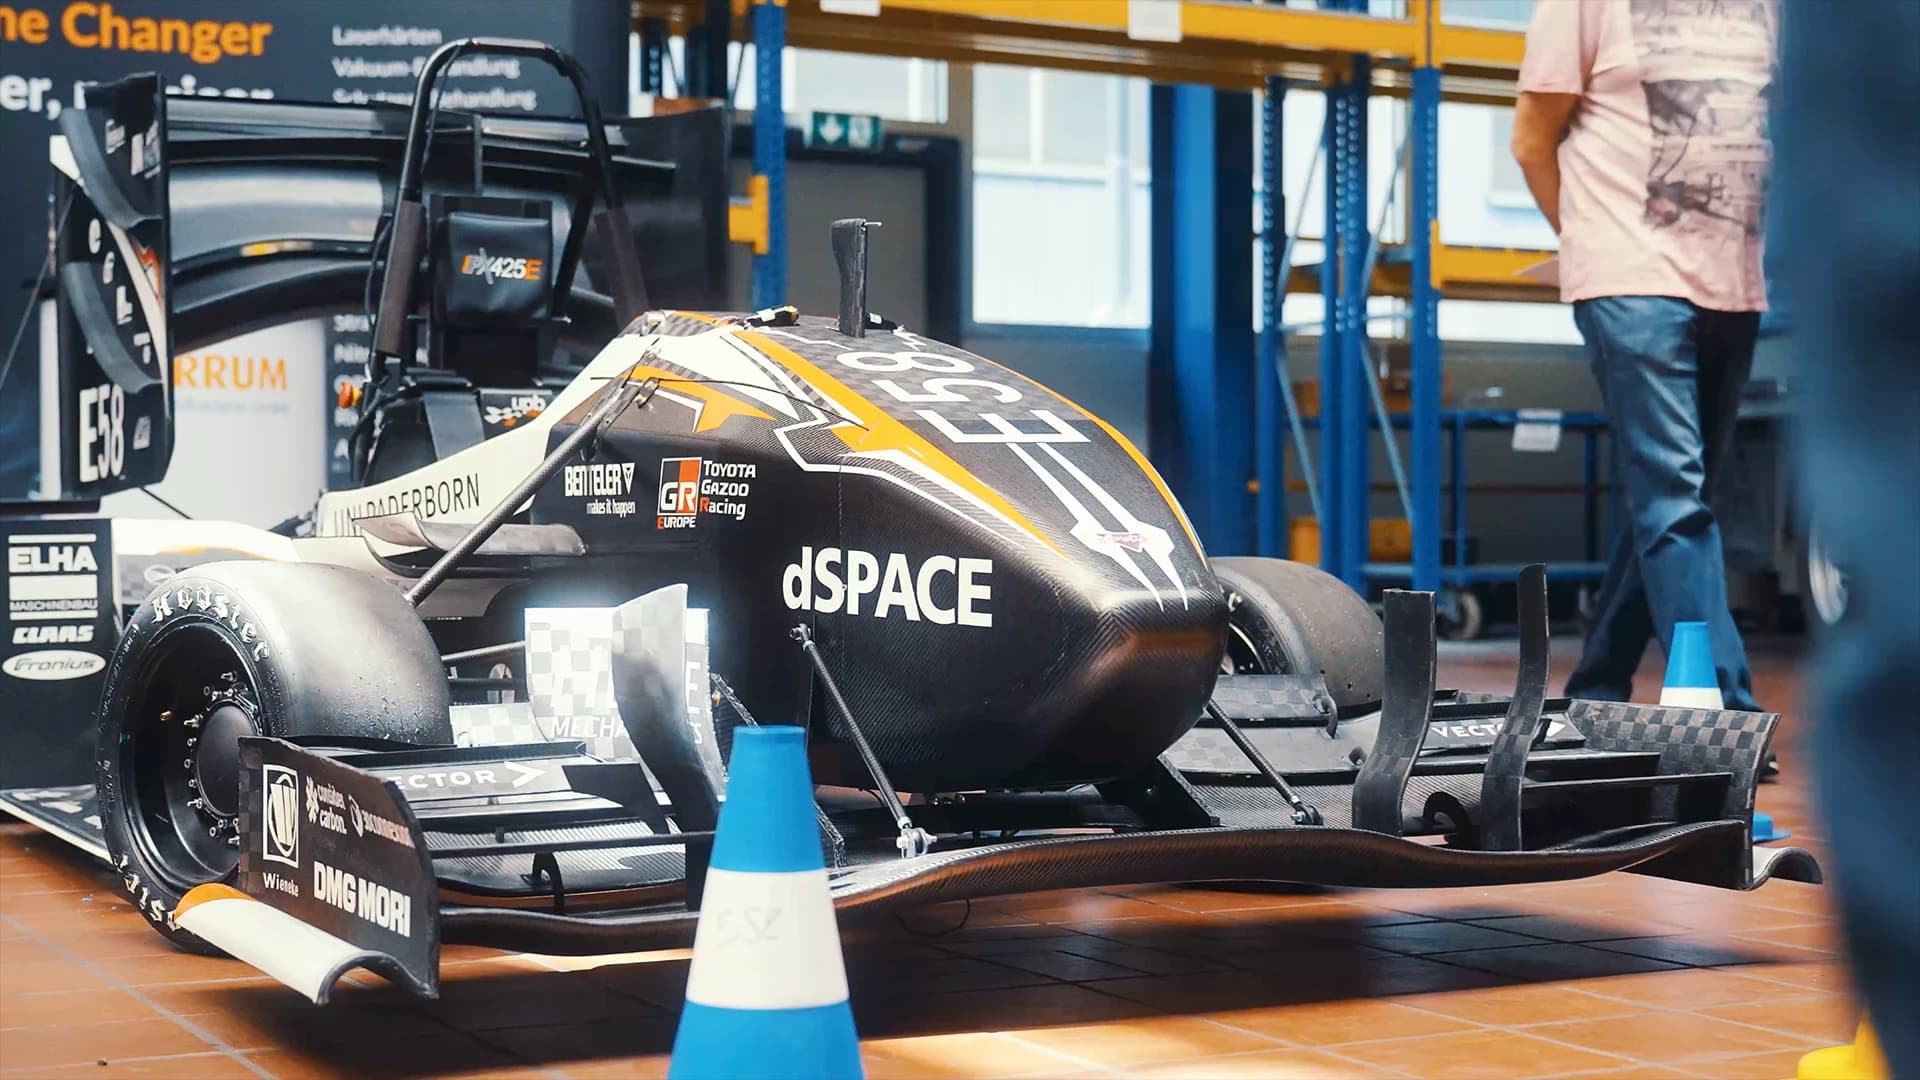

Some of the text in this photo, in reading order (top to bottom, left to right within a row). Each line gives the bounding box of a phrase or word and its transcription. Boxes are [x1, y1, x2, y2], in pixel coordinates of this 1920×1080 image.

[60, 1, 273, 64] Changer
[173, 354, 287, 391] RRUM
[79, 383, 125, 483] E58
[564, 463, 622, 497] BENTELER
[703, 460, 757, 478] TOYOTA
[661, 481, 697, 512] GR
[701, 479, 750, 497] GAZOO
[612, 498, 636, 519] happen
[700, 497, 747, 521] Racing
[656, 516, 697, 530] EUROPE
[9, 545, 98, 573] ELHA
[782, 546, 993, 628] dSPACE
[10, 599, 98, 612] MASCHINENBAU
[12, 624, 95, 645] CLAAS
[14, 657, 96, 673] Fronius
[1431, 723, 1504, 738] VECT
[385, 769, 497, 790] ECTOR
[263, 872, 300, 898] Wieneke
[314, 861, 412, 938] DMG MORI
